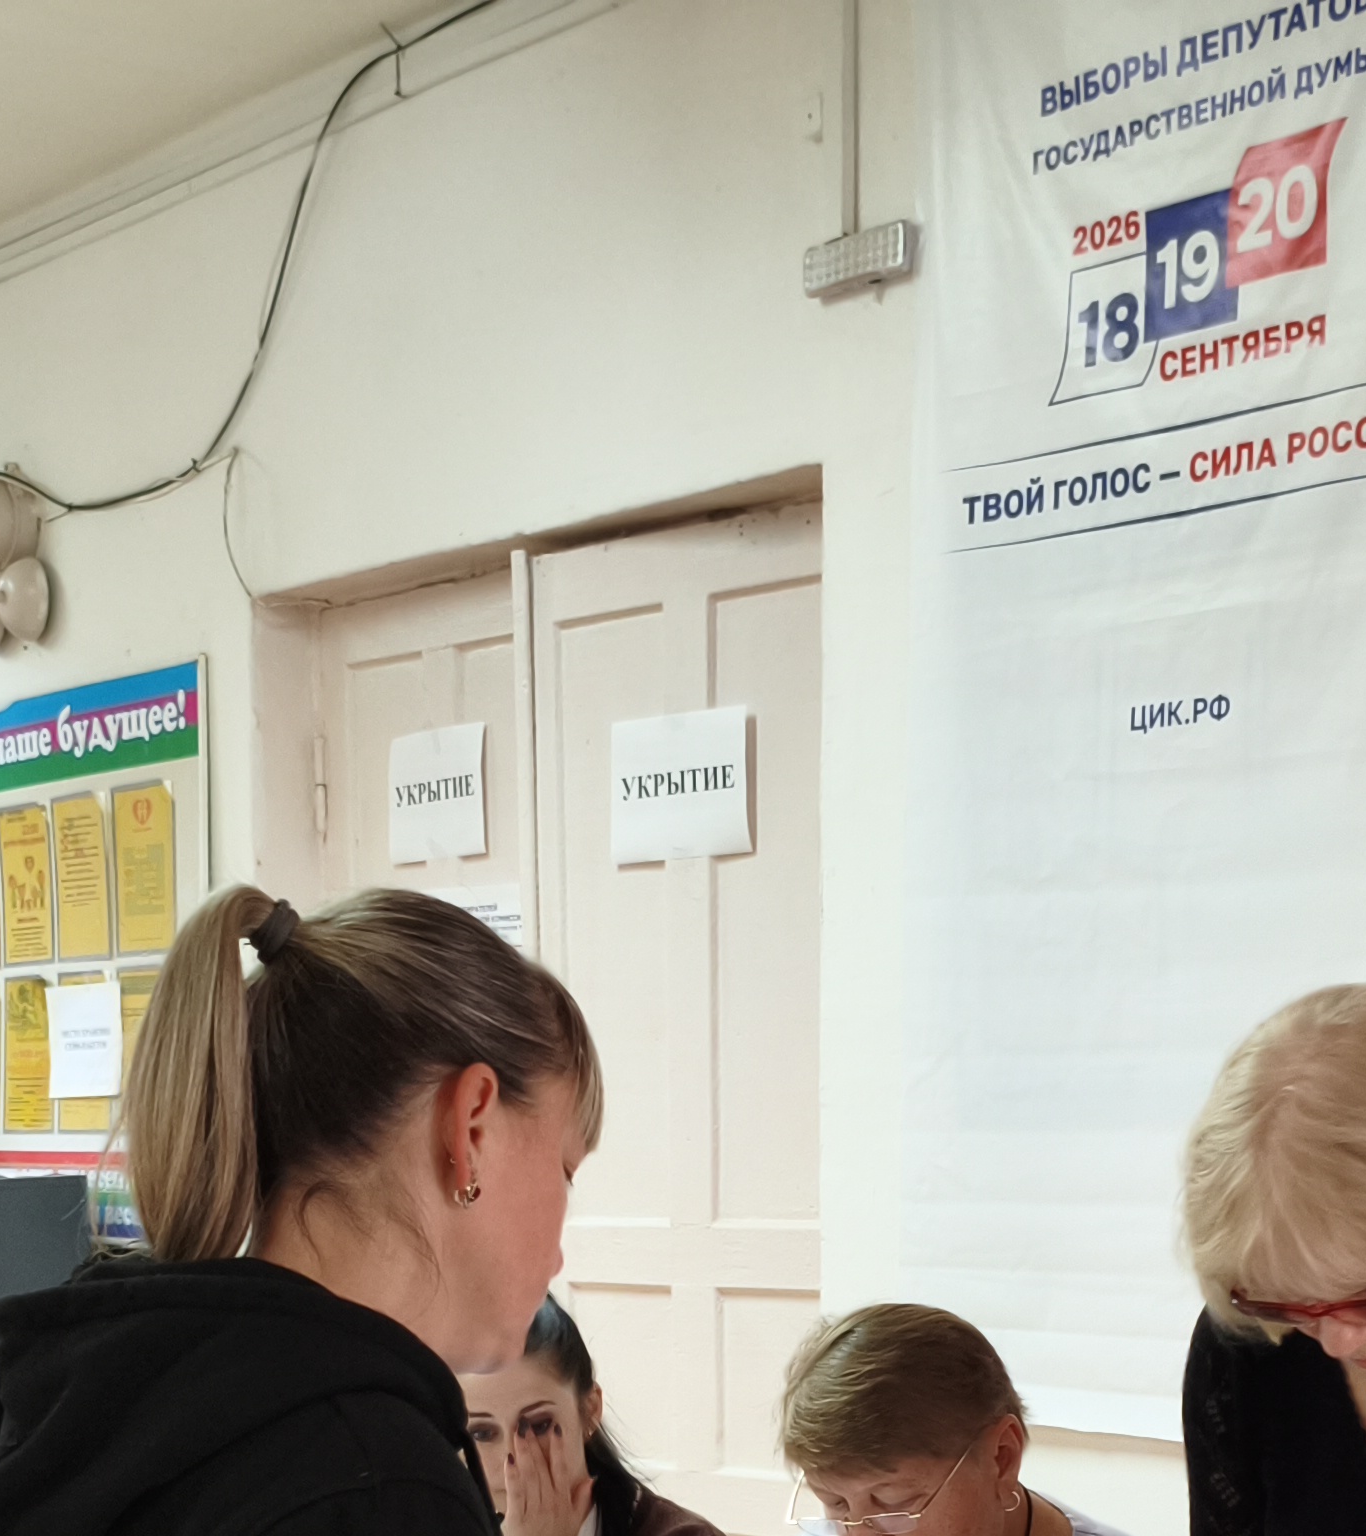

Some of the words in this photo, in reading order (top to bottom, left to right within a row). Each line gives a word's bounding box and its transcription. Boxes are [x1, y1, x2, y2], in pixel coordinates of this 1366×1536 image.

[1040, 45, 1169, 117] ВЫБОРЫ
[1033, 66, 1287, 175] ГОСУДАРСТВЕННОЙ
[1072, 210, 1141, 257] 2026
[1236, 165, 1318, 253] 20
[1156, 229, 1220, 310] 19
[1077, 292, 1141, 368] 18
[1158, 314, 1327, 382] СЕНТЯБРЯ
[962, 476, 1045, 526] ТВОЙ
[1052, 462, 1151, 511] ГОЛОС
[1188, 437, 1278, 484] СИЛА
[56, 688, 187, 759] будущее!
[1130, 694, 1231, 734] ЦИК.РФ
[395, 773, 475, 808] УКРЫТИЕ
[620, 763, 736, 802] УКРЫТИЕ
